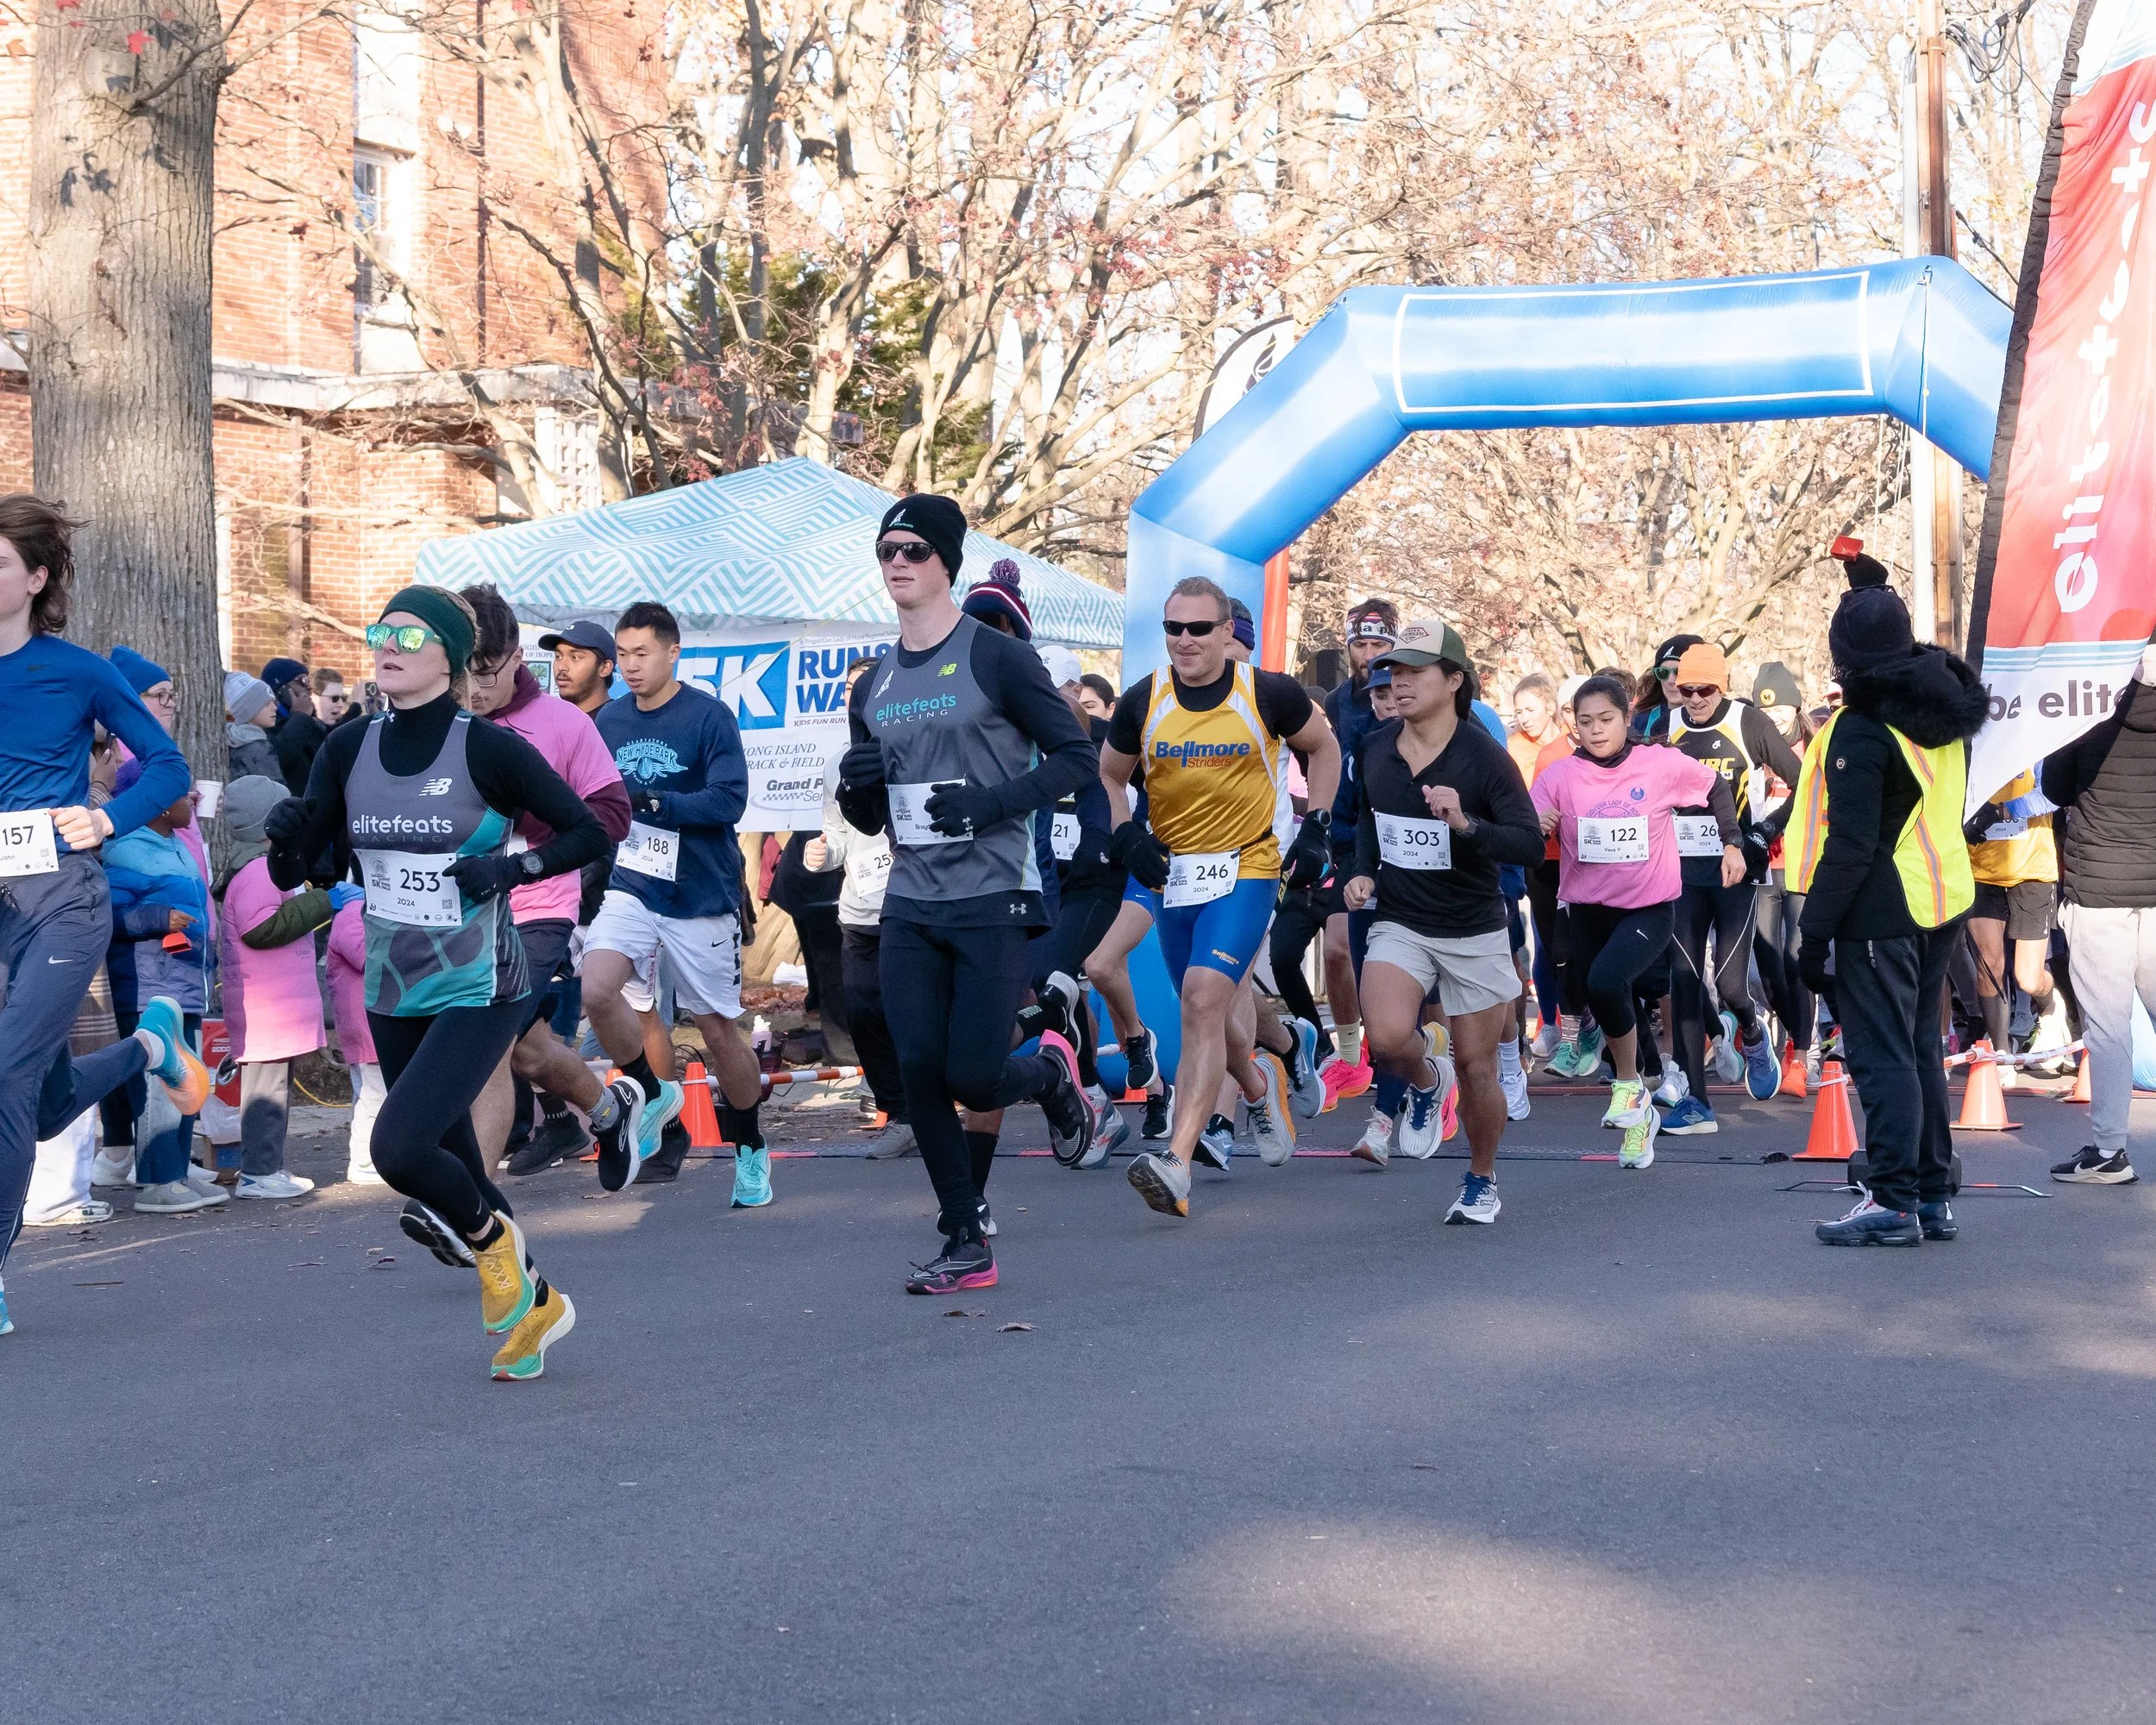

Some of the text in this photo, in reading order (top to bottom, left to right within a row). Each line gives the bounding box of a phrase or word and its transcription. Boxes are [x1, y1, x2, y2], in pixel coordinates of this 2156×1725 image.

[796, 682, 847, 713] WA
[875, 693, 956, 721] elitefeats
[1986, 683, 2021, 722] be
[881, 709, 948, 728] RACING
[617, 744, 677, 766] NEW HYDE PARK
[774, 743, 817, 755] ISLAND
[1156, 740, 1250, 768] Bellmore
[746, 756, 824, 769] RACK & FIELD
[1187, 757, 1232, 768] Striders
[767, 778, 811, 791] Grand
[352, 814, 454, 834] elitefeats
[3, 825, 34, 845] 157
[1403, 829, 1439, 846] 303
[1610, 827, 1637, 842] 122
[648, 836, 668, 855] 188
[400, 868, 441, 893] 253
[1195, 863, 1228, 881] 246
[397, 897, 416, 906] 2024
